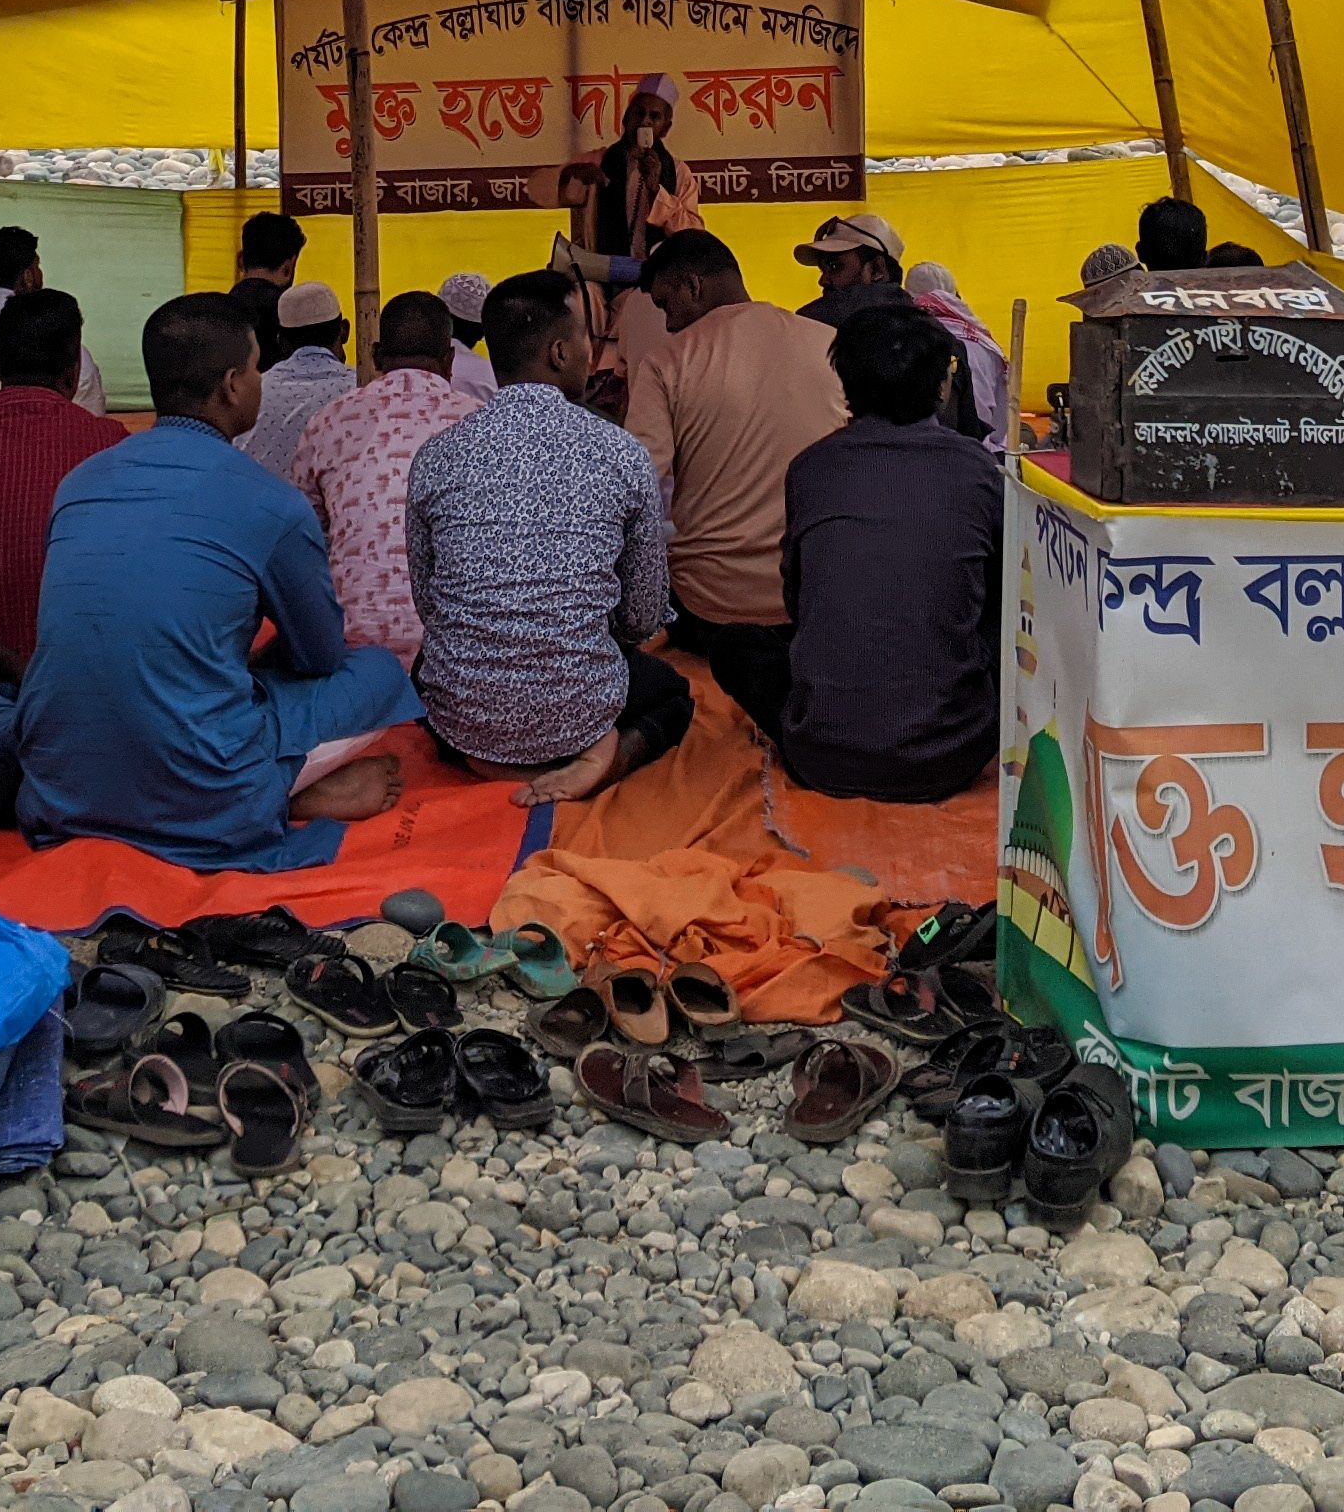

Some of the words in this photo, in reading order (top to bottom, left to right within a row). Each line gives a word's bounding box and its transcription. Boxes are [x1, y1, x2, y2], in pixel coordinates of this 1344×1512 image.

[371, 13, 432, 56] কেন্দ্র
[759, 4, 859, 60] মসজিদে
[432, 76, 554, 154] হস্তে
[682, 65, 846, 135] করুন
[768, 161, 854, 194] সিলেট
[1194, 318, 1244, 354] শাহী
[1247, 325, 1306, 364] জামে
